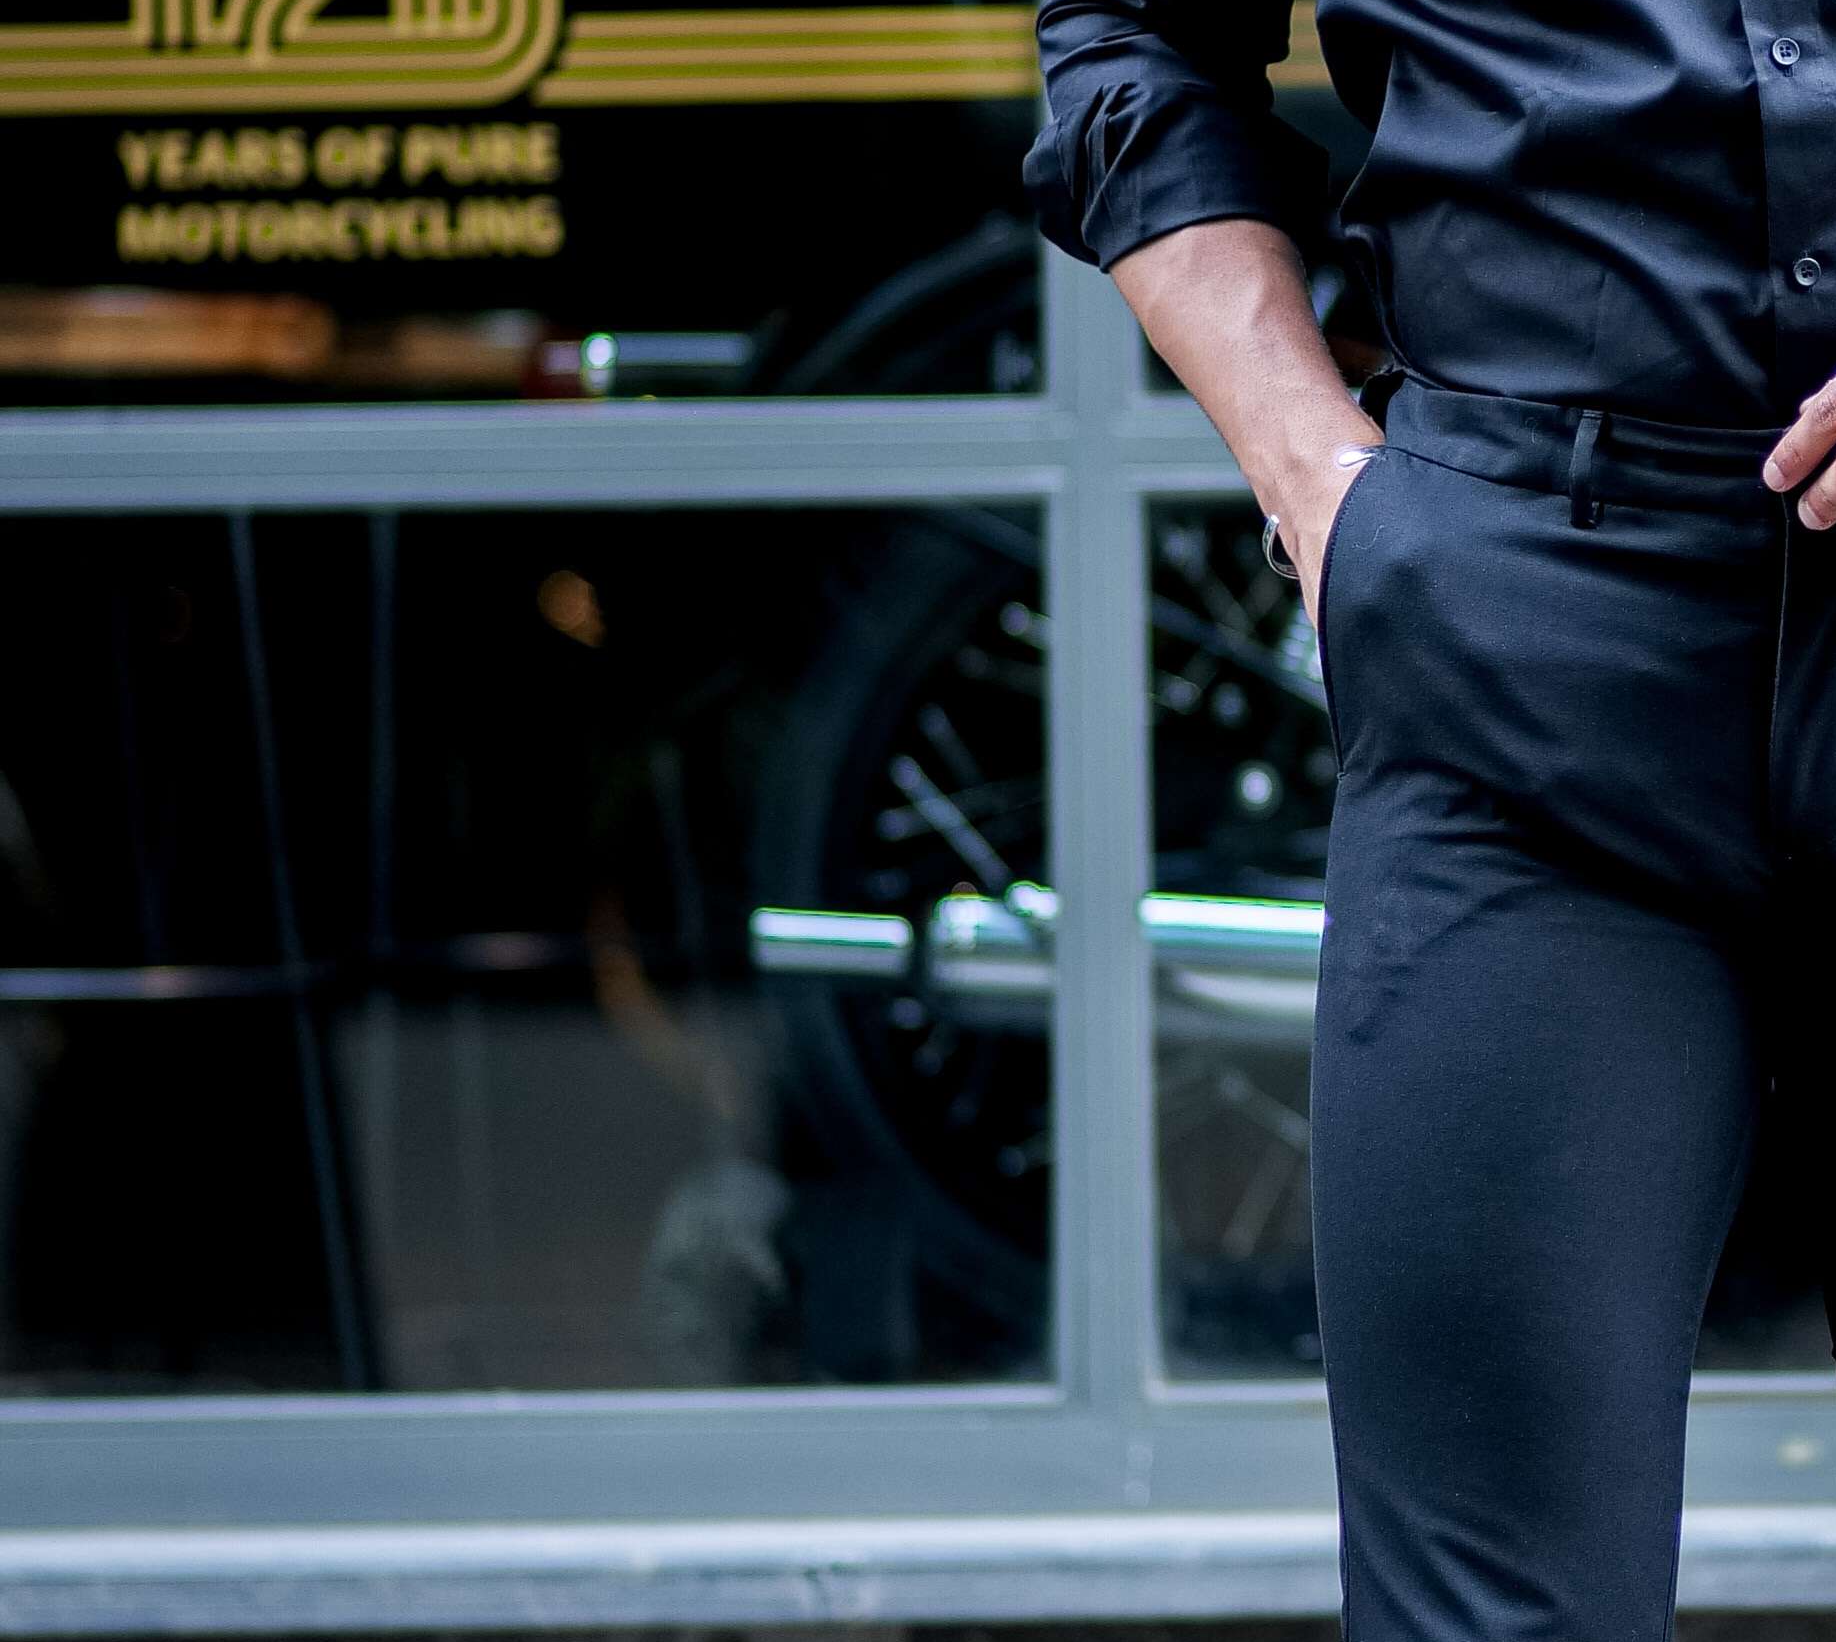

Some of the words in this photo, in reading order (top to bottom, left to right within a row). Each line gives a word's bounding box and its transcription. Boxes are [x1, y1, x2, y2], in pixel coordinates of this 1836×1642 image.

[119, 129, 307, 188] YEARS
[313, 127, 392, 185] OF
[401, 124, 558, 184] PURE
[118, 196, 564, 260] MOTORCYCLING
